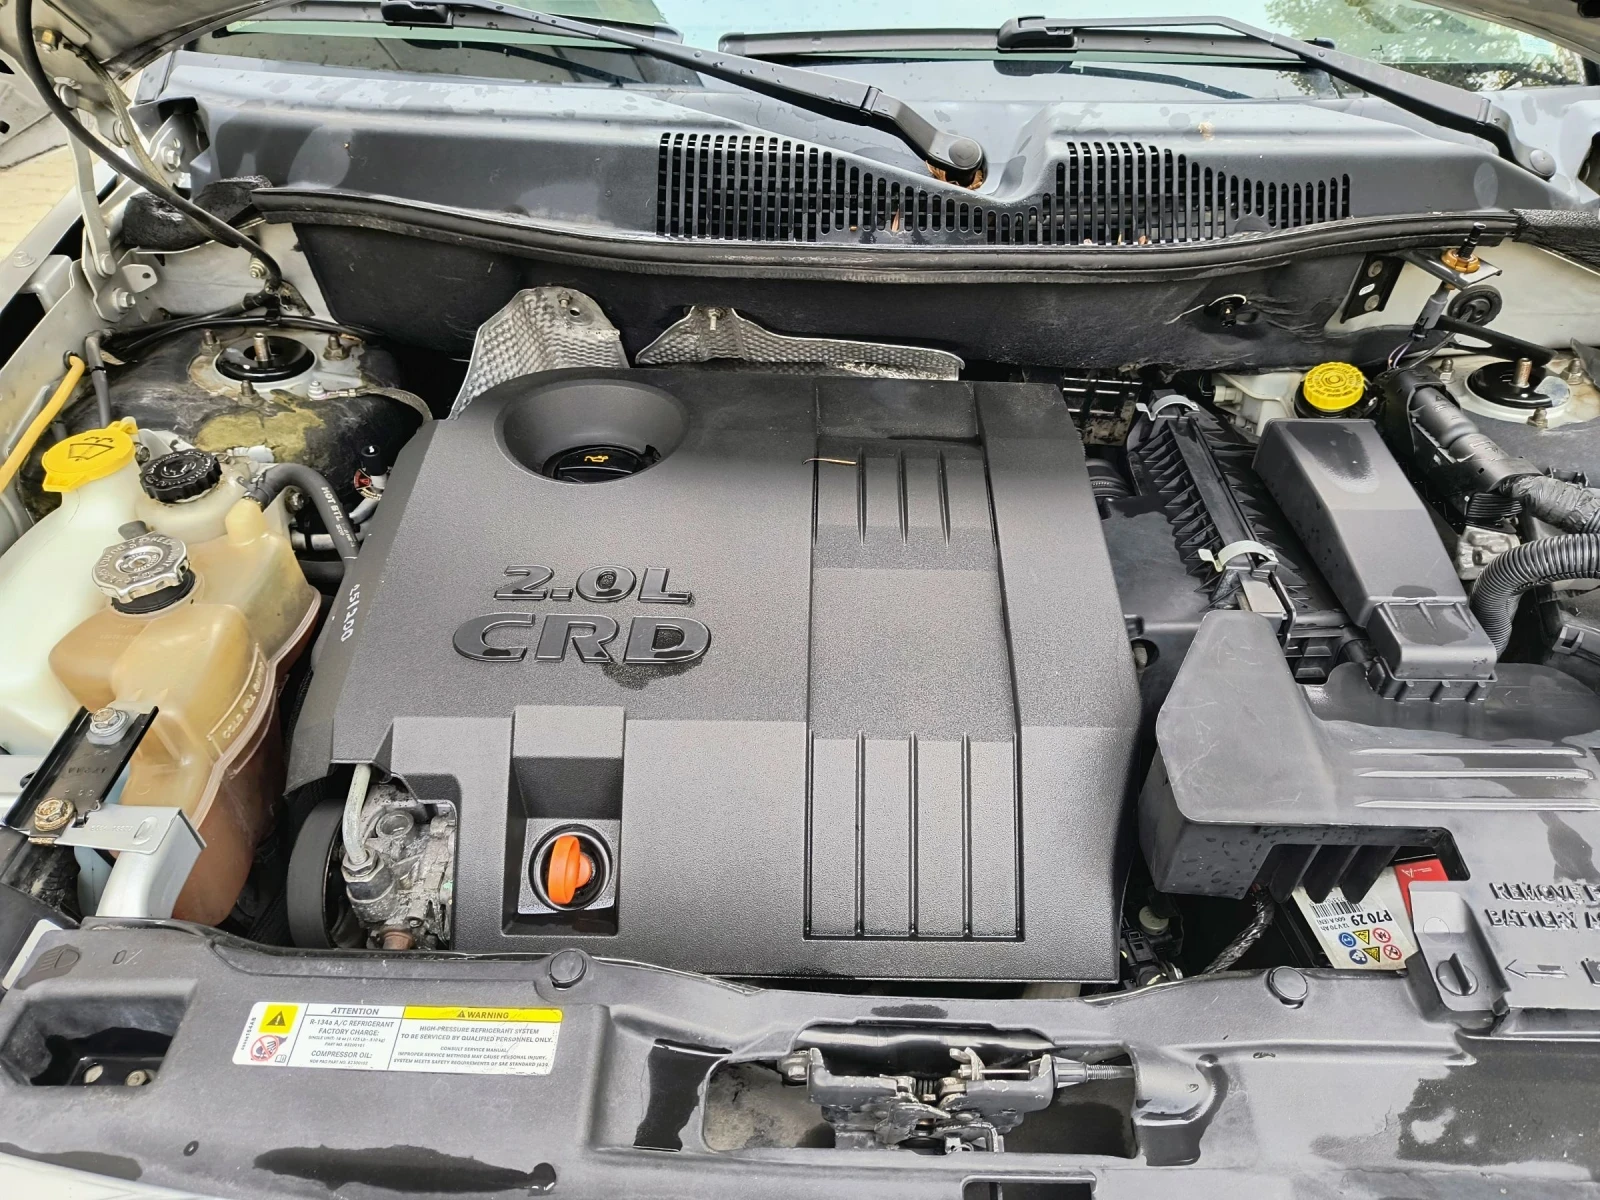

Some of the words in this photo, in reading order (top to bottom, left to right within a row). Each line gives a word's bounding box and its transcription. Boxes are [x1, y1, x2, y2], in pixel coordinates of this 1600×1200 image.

[321, 486, 336, 504] HOT
[330, 504, 343, 522] BTL
[493, 564, 692, 604] 2.0L
[453, 612, 711, 663] CRD
[1488, 882, 1582, 904] REMOVE
[1484, 908, 1578, 931] BATTERY
[331, 1007, 379, 1015] ATTENTION
[467, 1011, 509, 1019] WARNING
[309, 1018, 332, 1026] R-134a
[348, 1020, 394, 1028] REFRIGERANT
[311, 1050, 358, 1058] COMPRESSOR
